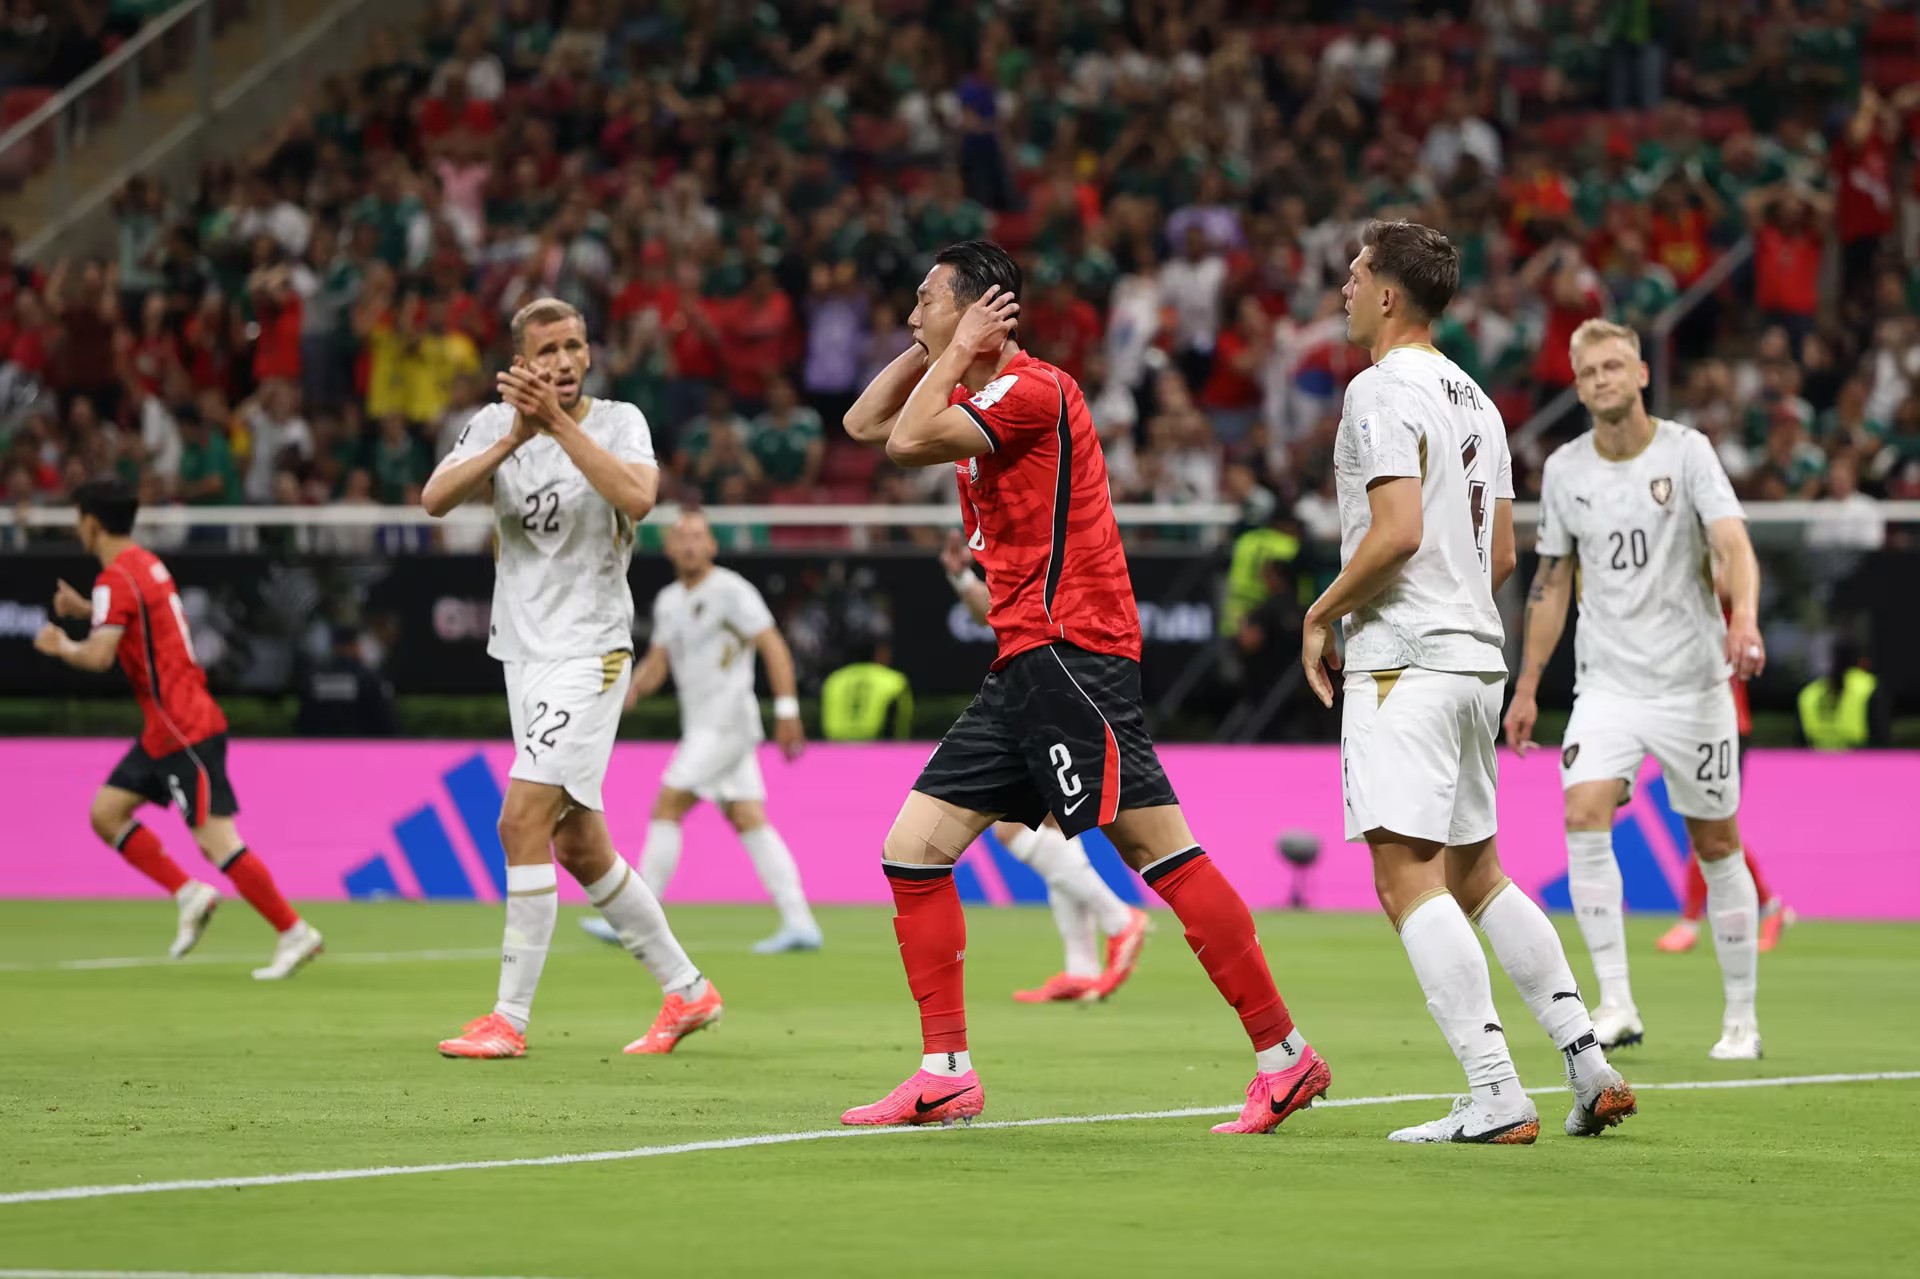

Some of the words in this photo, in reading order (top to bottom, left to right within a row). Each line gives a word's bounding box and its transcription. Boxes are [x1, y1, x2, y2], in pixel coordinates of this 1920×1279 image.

[522, 492, 560, 533] 22
[1608, 528, 1649, 571] 20
[526, 701, 571, 748] 22
[1049, 743, 1083, 797] 2
[1696, 740, 1731, 782] 20
